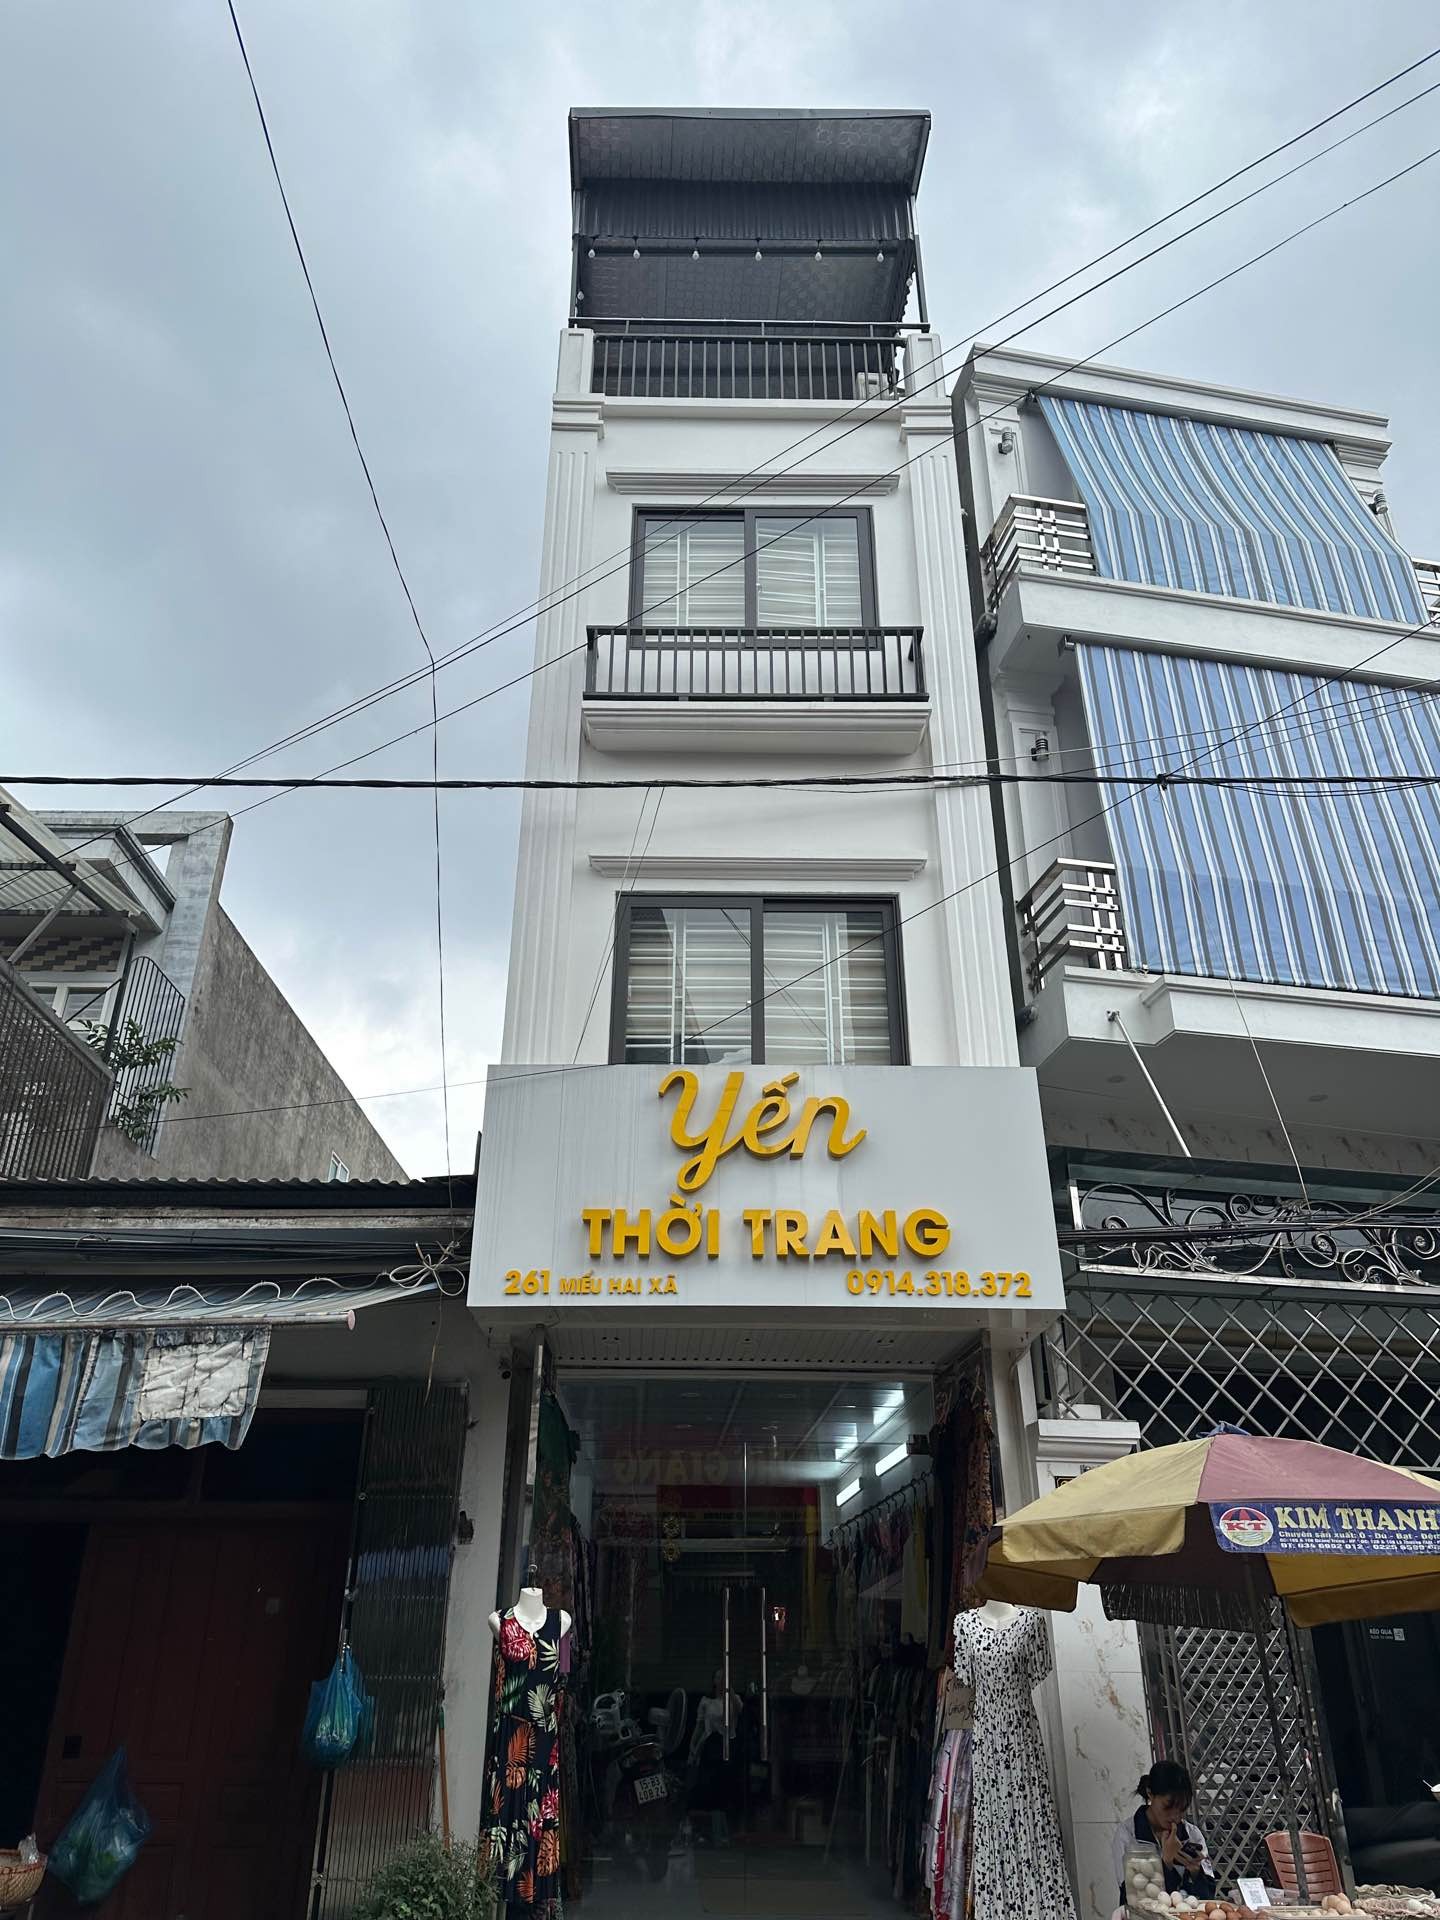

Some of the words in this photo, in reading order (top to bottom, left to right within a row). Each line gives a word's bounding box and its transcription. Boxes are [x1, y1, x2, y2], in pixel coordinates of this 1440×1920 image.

[582, 1193, 720, 1259] THỜI
[743, 1208, 951, 1258] TRANG
[504, 1268, 551, 1295] 261
[559, 1270, 602, 1295] MIẾU
[608, 1277, 641, 1295] HAI
[648, 1275, 678, 1295] XÃ
[847, 1268, 1033, 1298] 0914.318.372
[1225, 1522, 1266, 1531] KT
[1274, 1506, 1331, 1529] KIM
